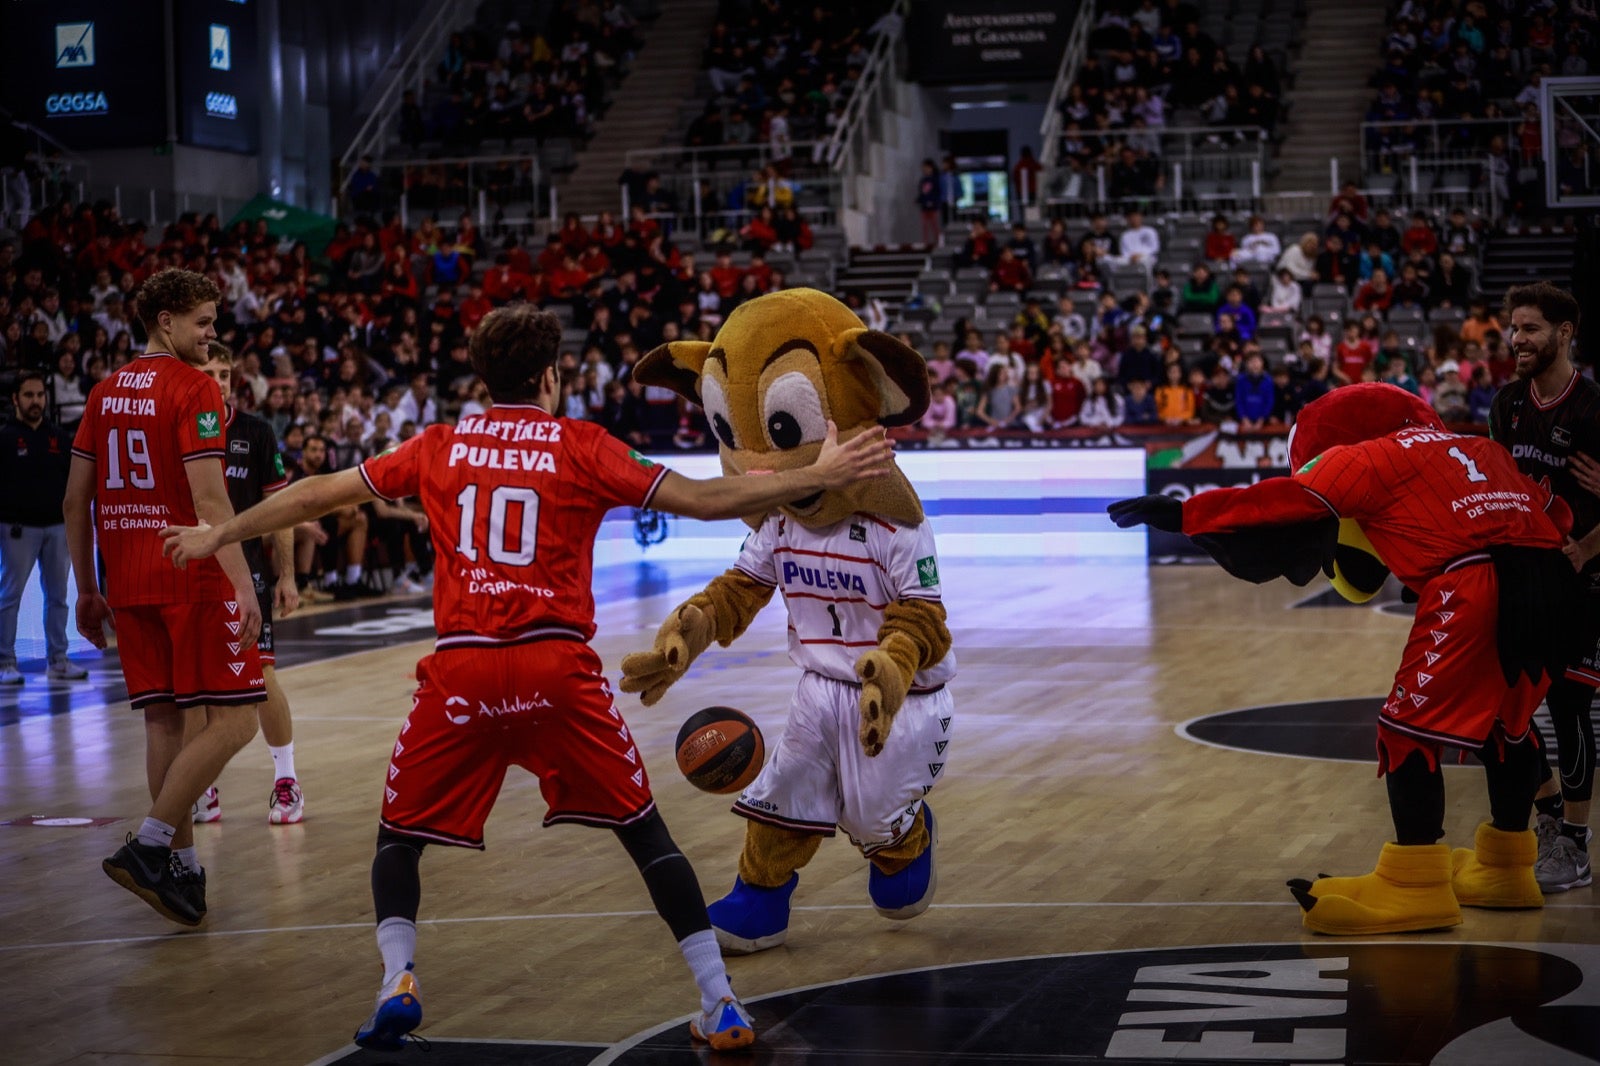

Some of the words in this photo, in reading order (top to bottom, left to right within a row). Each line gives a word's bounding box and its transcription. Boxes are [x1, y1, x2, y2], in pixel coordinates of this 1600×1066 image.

[105, 427, 156, 490] 19
[448, 442, 557, 474] PULEVA
[1447, 446, 1487, 483] 1
[104, 520, 117, 530] DE
[120, 517, 168, 529] GRANDA
[456, 484, 540, 567] 10
[1466, 505, 1485, 519] DE
[784, 561, 867, 596] PULEVA
[827, 604, 842, 637] 1
[478, 691, 554, 718] Andalucía
